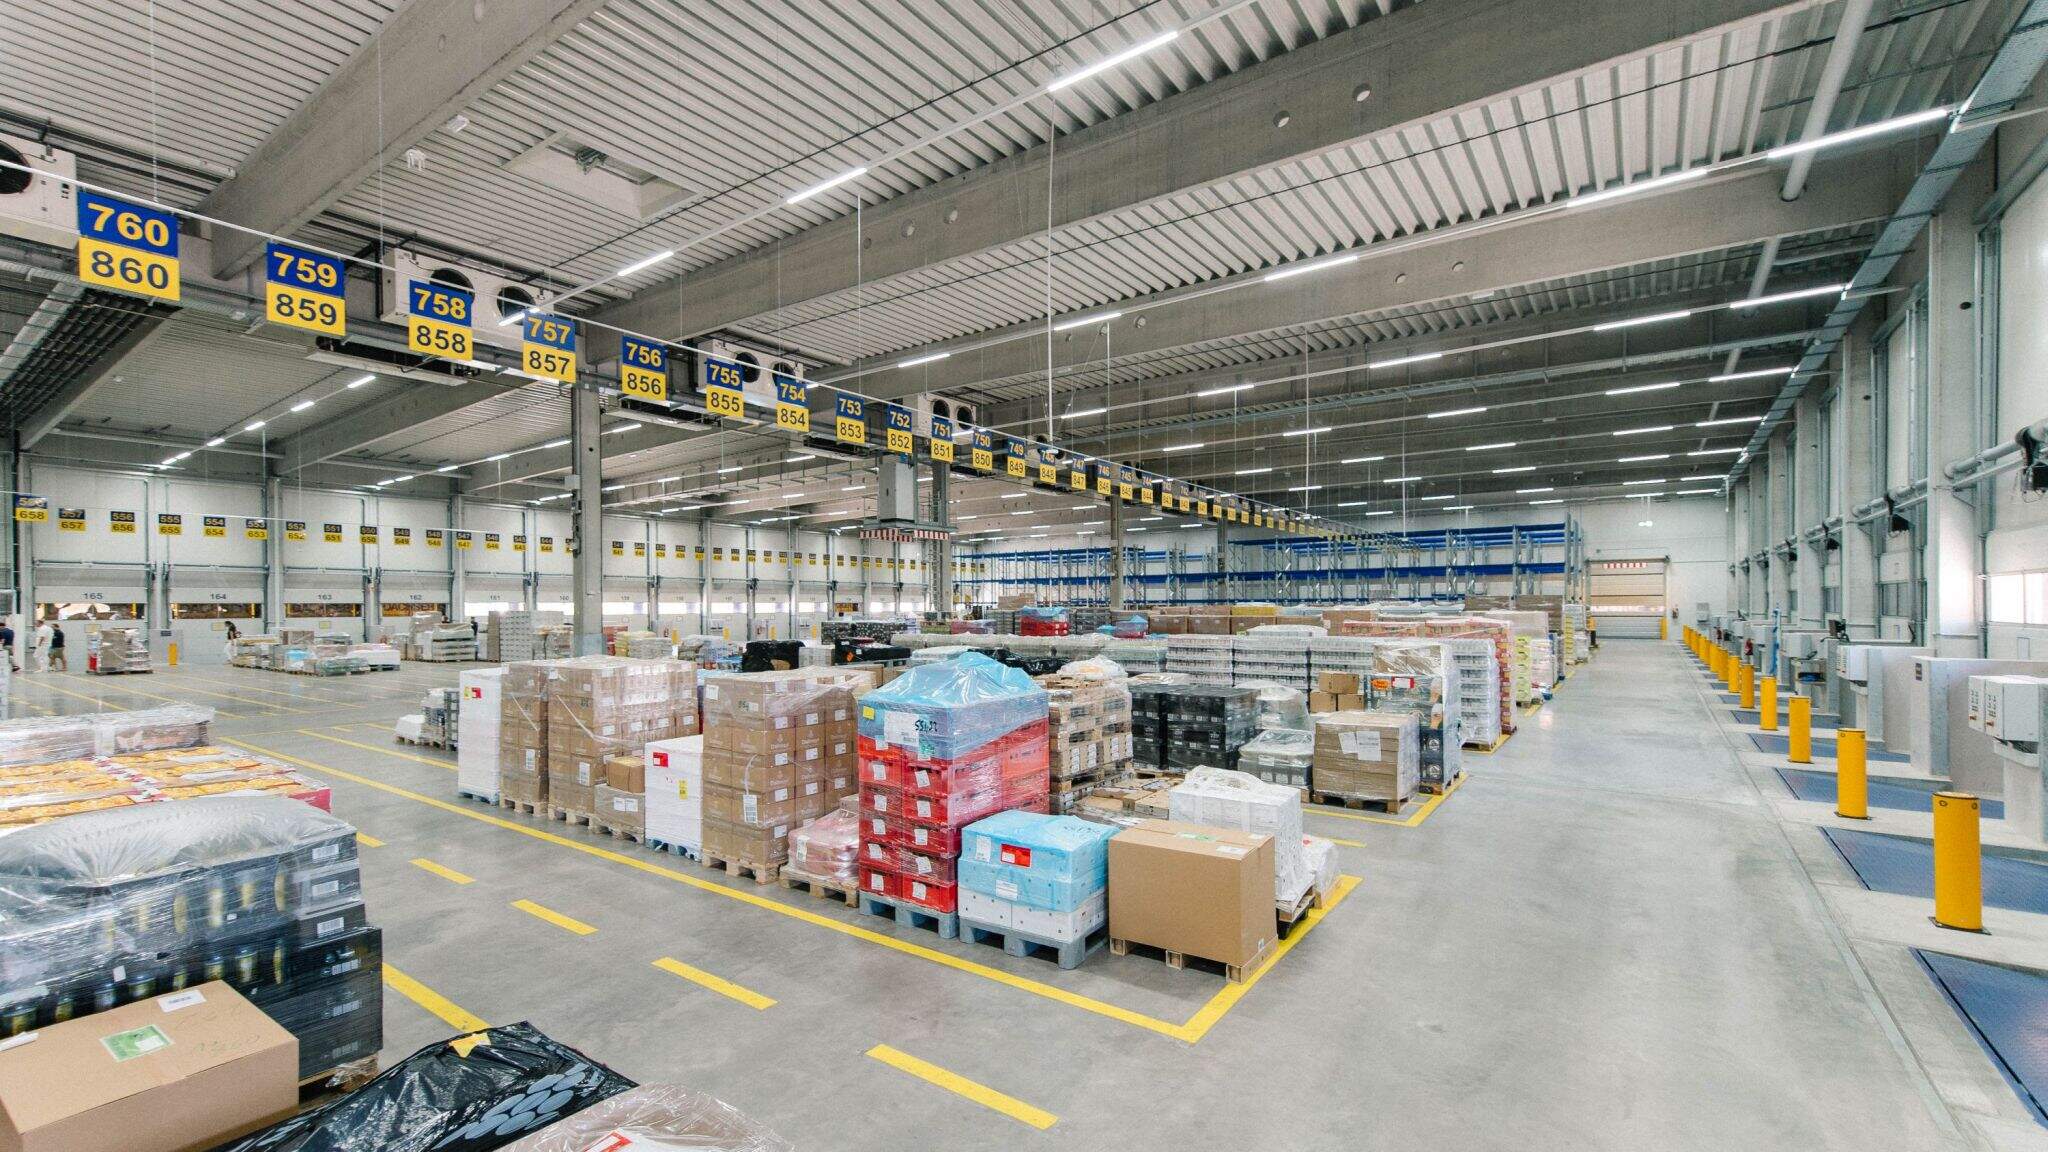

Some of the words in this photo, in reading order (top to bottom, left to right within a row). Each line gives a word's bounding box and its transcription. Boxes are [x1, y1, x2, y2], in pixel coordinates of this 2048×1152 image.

[88, 202, 170, 248] 760
[90, 250, 170, 291] 860
[273, 252, 338, 288] 759
[275, 293, 338, 327] 859
[414, 288, 467, 321] 758
[528, 316, 572, 345] 757
[416, 325, 467, 356] 858
[626, 342, 662, 367] 756
[529, 350, 571, 377] 857
[710, 364, 740, 386] 755
[627, 373, 662, 396] 856
[780, 383, 806, 404] 754
[711, 392, 740, 413] 855
[839, 397, 862, 416] 753
[780, 408, 806, 426] 854
[890, 411, 911, 429] 752
[839, 422, 862, 439] 853
[933, 422, 951, 439] 751
[890, 433, 910, 449] 852
[974, 432, 991, 448] 750
[1009, 441, 1024, 456] 749
[933, 443, 951, 458] 851
[974, 452, 990, 467] 850
[1009, 460, 1024, 474] 849
[19, 510, 45, 520] 658
[112, 512, 133, 521] 556
[160, 515, 180, 524] 555
[205, 518, 225, 527] 554
[61, 521, 84, 530] 657
[112, 524, 133, 532] 656
[160, 526, 180, 534] 655
[205, 528, 225, 536] 654
[248, 530, 266, 538] 653
[82, 592, 103, 600] 165
